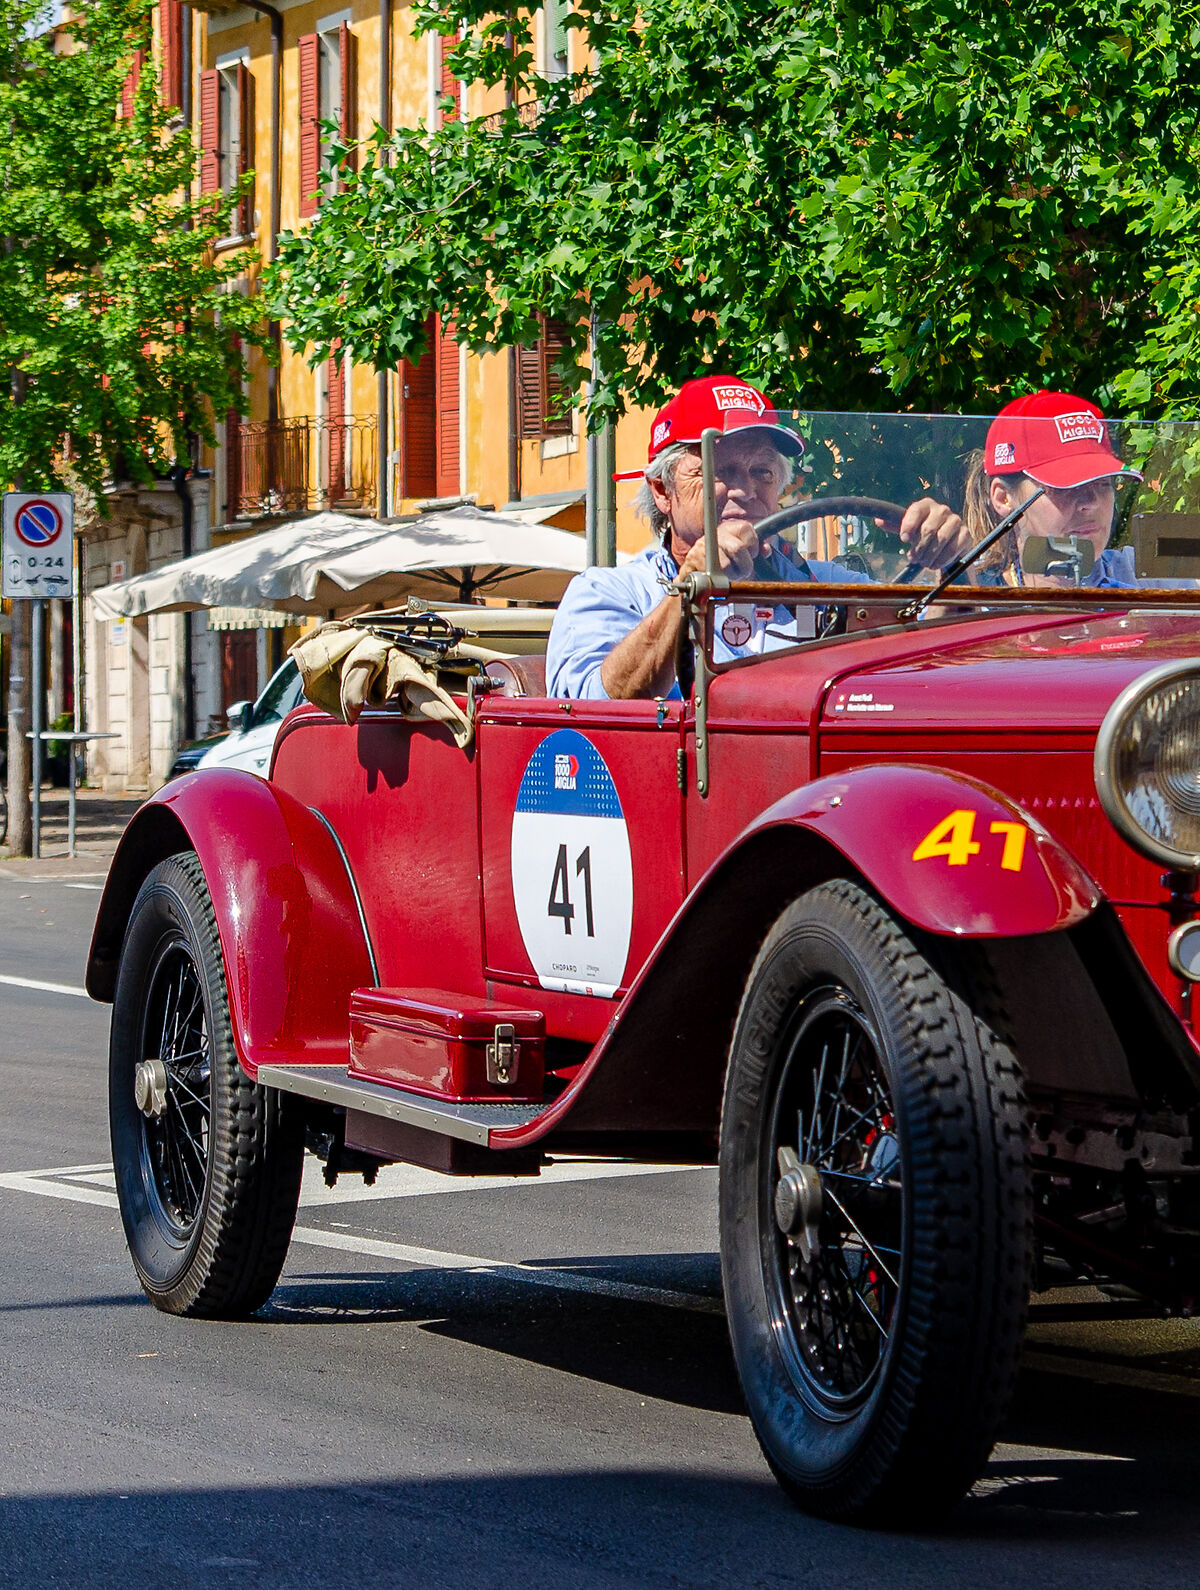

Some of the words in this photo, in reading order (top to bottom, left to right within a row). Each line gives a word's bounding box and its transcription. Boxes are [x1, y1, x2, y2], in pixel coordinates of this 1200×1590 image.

[720, 389, 753, 400] 1000
[720, 398, 758, 411] MIGLIA
[1061, 415, 1092, 427] 1000
[1063, 427, 1097, 439] MIGLIA
[554, 763, 571, 777] 1000
[554, 776, 577, 790] MIGLIA
[911, 808, 1028, 873] 41
[548, 843, 595, 938] 41
